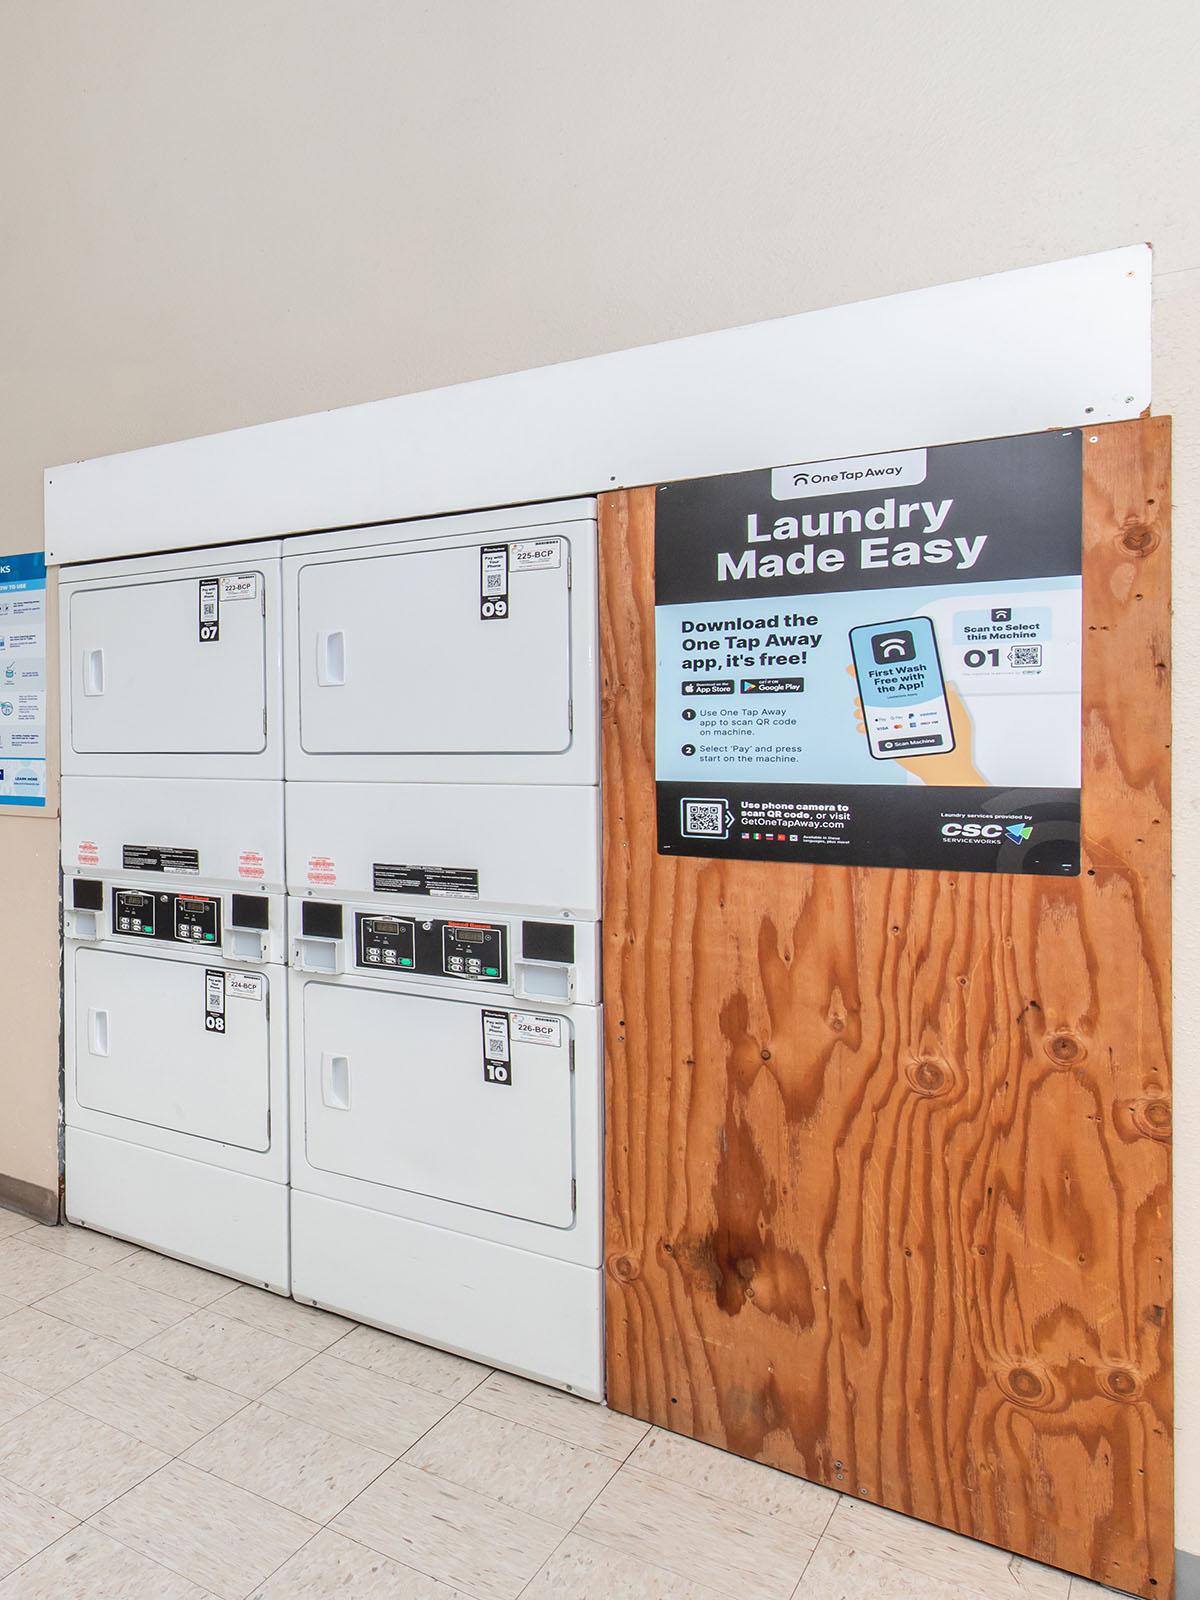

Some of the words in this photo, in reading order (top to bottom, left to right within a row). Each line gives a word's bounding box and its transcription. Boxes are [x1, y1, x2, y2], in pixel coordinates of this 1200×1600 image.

[810, 472, 838, 485] One
[839, 470, 863, 483] Tap
[864, 465, 903, 480] Away
[746, 498, 954, 543] Laundry
[517, 550, 553, 560] 225-BCP
[717, 548, 845, 581] Made
[860, 535, 988, 569] Easy
[482, 601, 507, 616] 09
[682, 615, 779, 633] Download
[784, 614, 818, 627] the
[201, 627, 217, 639] 07
[682, 639, 720, 651] One
[725, 636, 760, 651] Tap
[766, 634, 822, 648] Away
[682, 658, 722, 672] app,
[726, 654, 754, 667] it's
[760, 652, 807, 666] free!
[964, 649, 999, 668] 01
[869, 668, 893, 678] First
[896, 664, 926, 674] Wash
[874, 677, 897, 685] Free
[900, 673, 924, 682] with
[877, 685, 895, 693] the
[898, 681, 924, 692] App!
[742, 709, 758, 717] Tap
[761, 708, 786, 716] Away
[756, 755, 798, 763] machine.
[762, 803, 794, 811] phone
[783, 812, 813, 820] code,
[830, 812, 851, 820] visit
[741, 818, 844, 829] GetOneTapAway.com
[942, 823, 1003, 837] CSC
[231, 982, 256, 990] 224-BCP
[207, 1016, 224, 1030] 08
[518, 1024, 553, 1034] 226-BCP
[487, 1066, 507, 1081] 10
